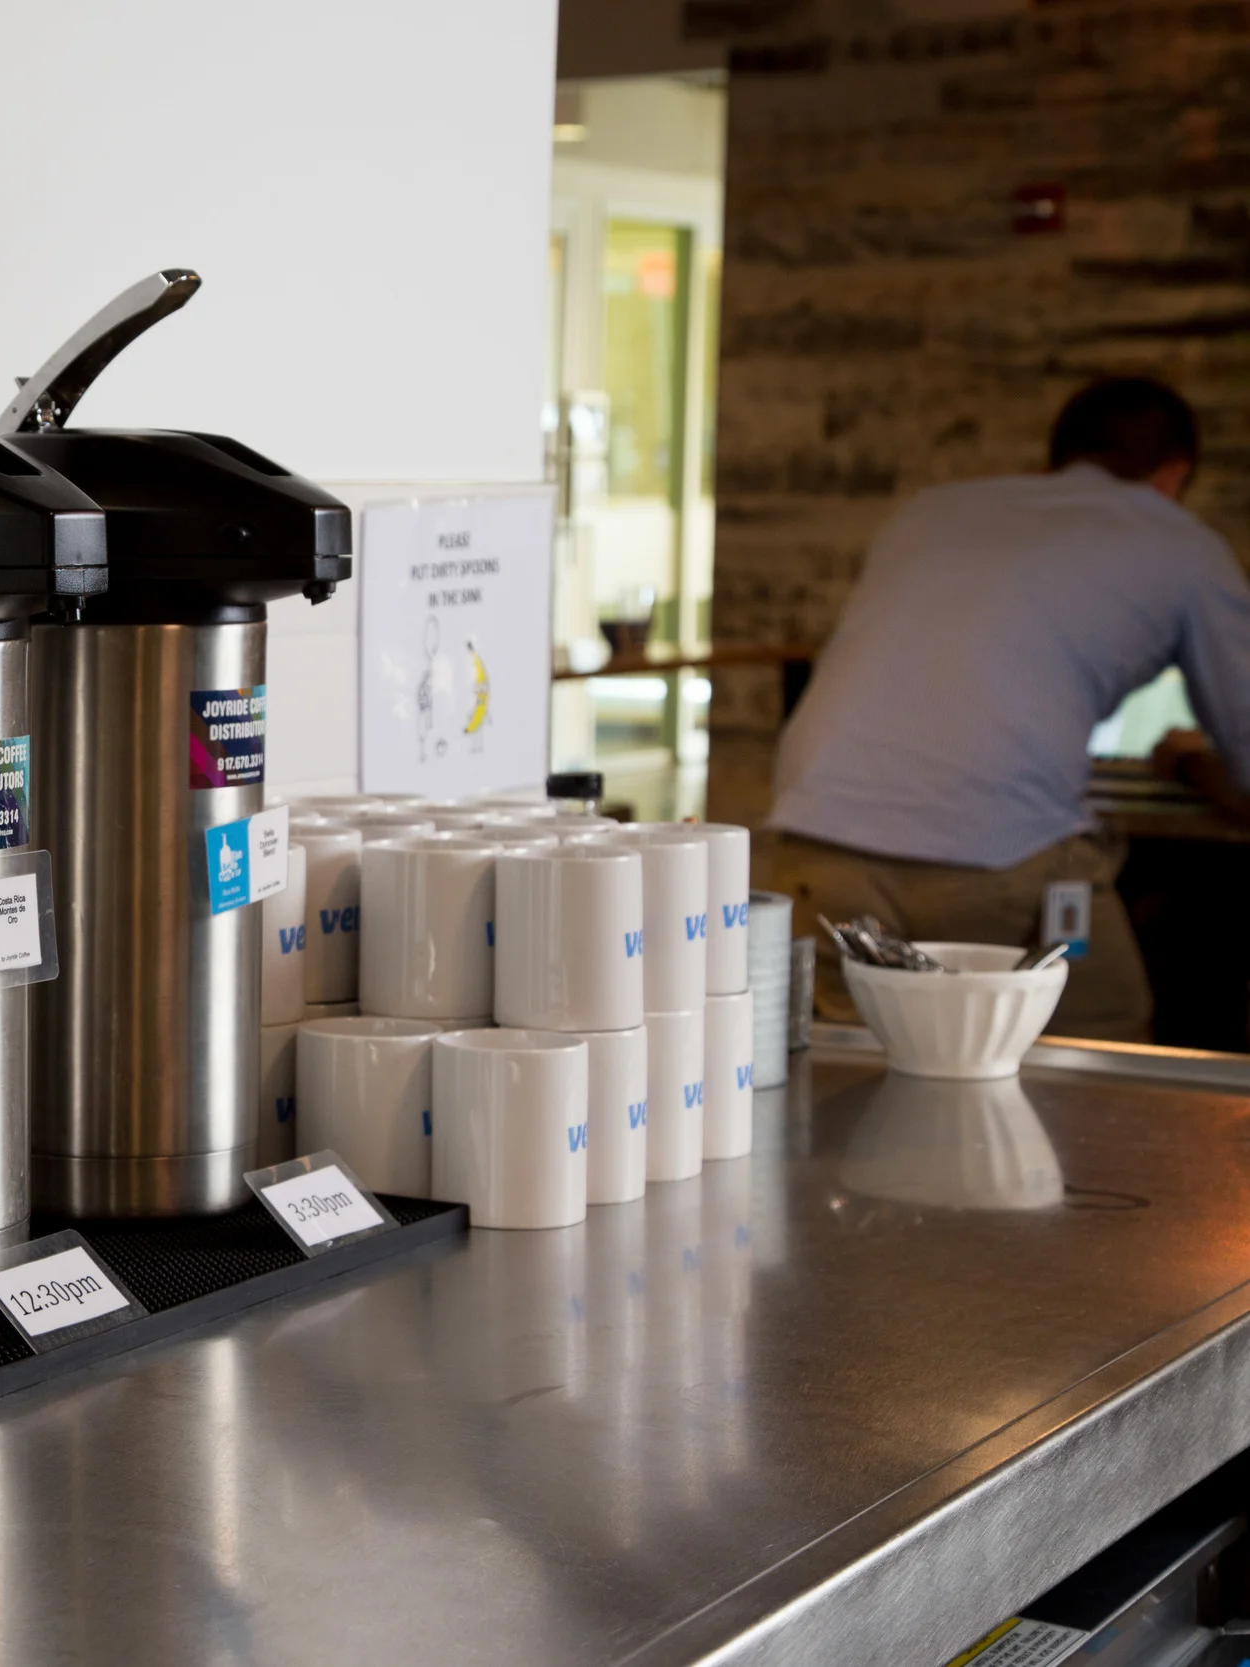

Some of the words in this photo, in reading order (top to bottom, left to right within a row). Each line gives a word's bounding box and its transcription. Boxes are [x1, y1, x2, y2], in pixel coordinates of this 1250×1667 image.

[461, 558, 500, 577] SPOONS
[202, 698, 248, 718] JOYRIDE
[13, 894, 26, 903] Rica
[0, 906, 18, 916] Montes
[19, 904, 26, 912] de
[8, 916, 18, 924] Oro
[287, 1188, 353, 1223] 3:30pm
[10, 1273, 104, 1317] 12:30pm
